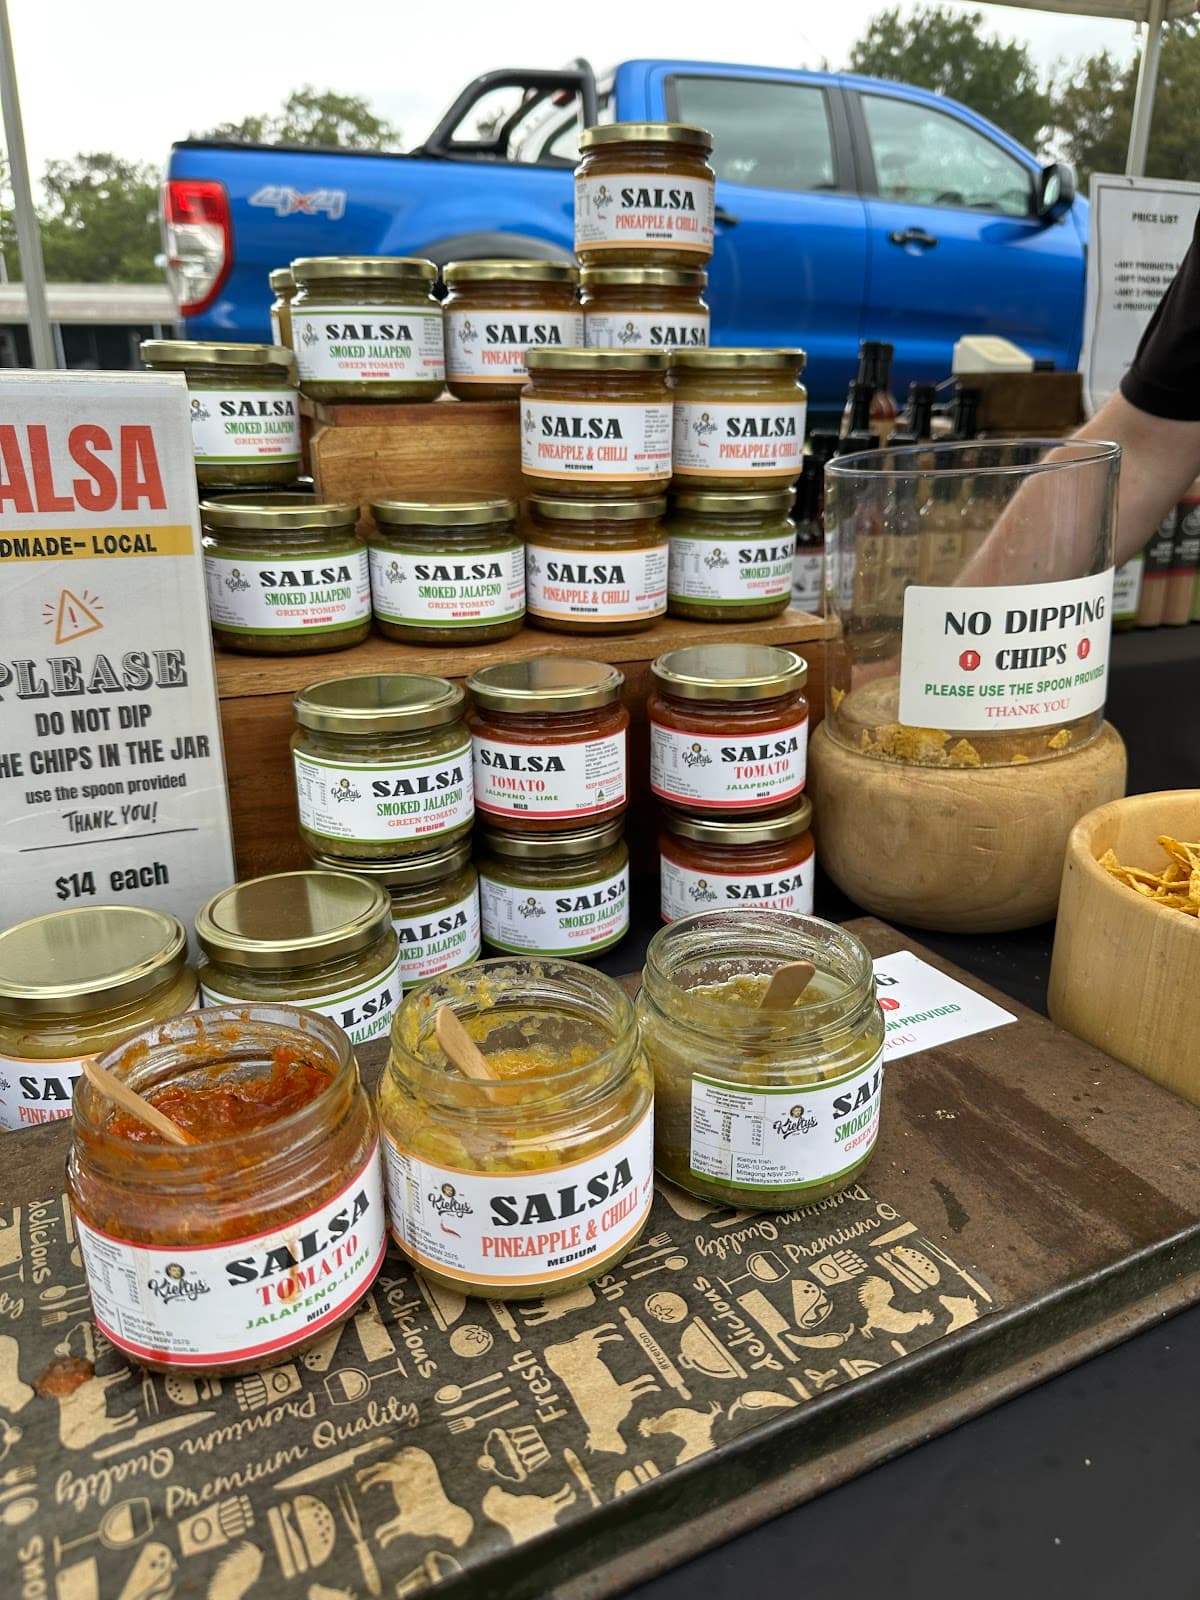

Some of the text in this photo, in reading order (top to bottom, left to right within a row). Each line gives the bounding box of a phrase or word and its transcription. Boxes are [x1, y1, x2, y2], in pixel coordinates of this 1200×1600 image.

[621, 188, 695, 211] SALSA
[616, 214, 664, 230] PINEAPPLE
[667, 215, 673, 230] &
[675, 216, 698, 232] CHILLI
[1132, 213, 1179, 224] PRICE LIST
[326, 324, 413, 341] SALSA
[486, 325, 562, 344] SALSA
[650, 327, 706, 346] SALSA
[329, 345, 412, 359] SMOKED JALAPENO
[219, 400, 295, 417] SALSA
[224, 422, 262, 435] SMOKED
[541, 416, 623, 439] SALSA
[726, 417, 796, 438] SALSA
[538, 443, 584, 461] PINEAPPLE
[586, 445, 595, 461] &
[596, 446, 628, 462] CHILLI
[720, 443, 770, 459] PINEAPPLE
[771, 444, 777, 458] &
[0, 424, 167, 514] ALSA
[93, 533, 157, 554] LOCAL
[259, 566, 352, 588] SALSA
[414, 562, 503, 582] SALSA
[547, 561, 626, 584] SALSA
[740, 566, 771, 580] SMOKED
[265, 587, 351, 606] SMOKED JALAPENO
[418, 583, 502, 599] SMOKED JALAPENO
[543, 585, 589, 604] PINEAPPLE
[591, 589, 599, 604] &
[601, 590, 631, 605] CHILLI
[276, 604, 346, 617] GREEN TOMATO
[428, 599, 496, 609] GREEN TOMATO
[452, 610, 481, 618] MEDIUM
[944, 611, 992, 635] NO
[1005, 595, 1105, 635] DIPPING
[995, 643, 1067, 671] CHIPS
[924, 677, 1072, 698] PLEASE USE THE SPOON
[35, 703, 153, 737] DO NOT DIP
[985, 698, 1071, 719] THANK YOU
[0, 734, 210, 779] HE CHIPS IN THE JAR
[480, 749, 566, 773] SALSA
[720, 736, 799, 763] SALSA
[734, 758, 789, 779] TOMATO
[25, 772, 187, 804] use the spoon provided
[371, 766, 464, 798] SALSA
[490, 774, 546, 793] TOMATO
[377, 787, 463, 817] SMOKED JALAPENO
[485, 788, 526, 801] JALAPENO
[62, 801, 158, 834] THANK YOU!
[388, 807, 458, 827] GREEN TOMATO
[415, 821, 445, 833] MEDIUM
[56, 862, 170, 901] $14 each
[726, 874, 803, 899] SALSA
[555, 878, 626, 913] SALSA
[399, 910, 468, 943] ALSA
[559, 912, 595, 929] SMOKED
[426, 929, 466, 956] JALAPENO
[568, 928, 595, 938] GREEN
[400, 948, 462, 972] REEN TOMATO
[340, 988, 393, 1028] LSA
[898, 1003, 962, 1026] PROVIDED
[834, 1105, 873, 1143] SMOKED
[844, 1125, 871, 1152] GREEN
[760, 1164, 779, 1172] Owen
[489, 1157, 633, 1227] SALSA
[481, 1186, 638, 1258] PINEAPPLE & CHILLI
[694, 1183, 871, 1260] Premium Quality
[28, 1199, 60, 1285] delicious
[225, 1189, 371, 1287] SALSA
[782, 1218, 881, 1264] Premium
[547, 1244, 598, 1268] MEDIUM
[256, 1234, 358, 1307] TOMATO
[306, 1302, 331, 1322] MILD
[692, 1276, 785, 1371] delicious
[378, 1276, 438, 1379] delicious
[507, 1349, 568, 1423] Fresh
[55, 1390, 316, 1512] Premium Quality
[165, 1397, 421, 1519] Premium Quality
